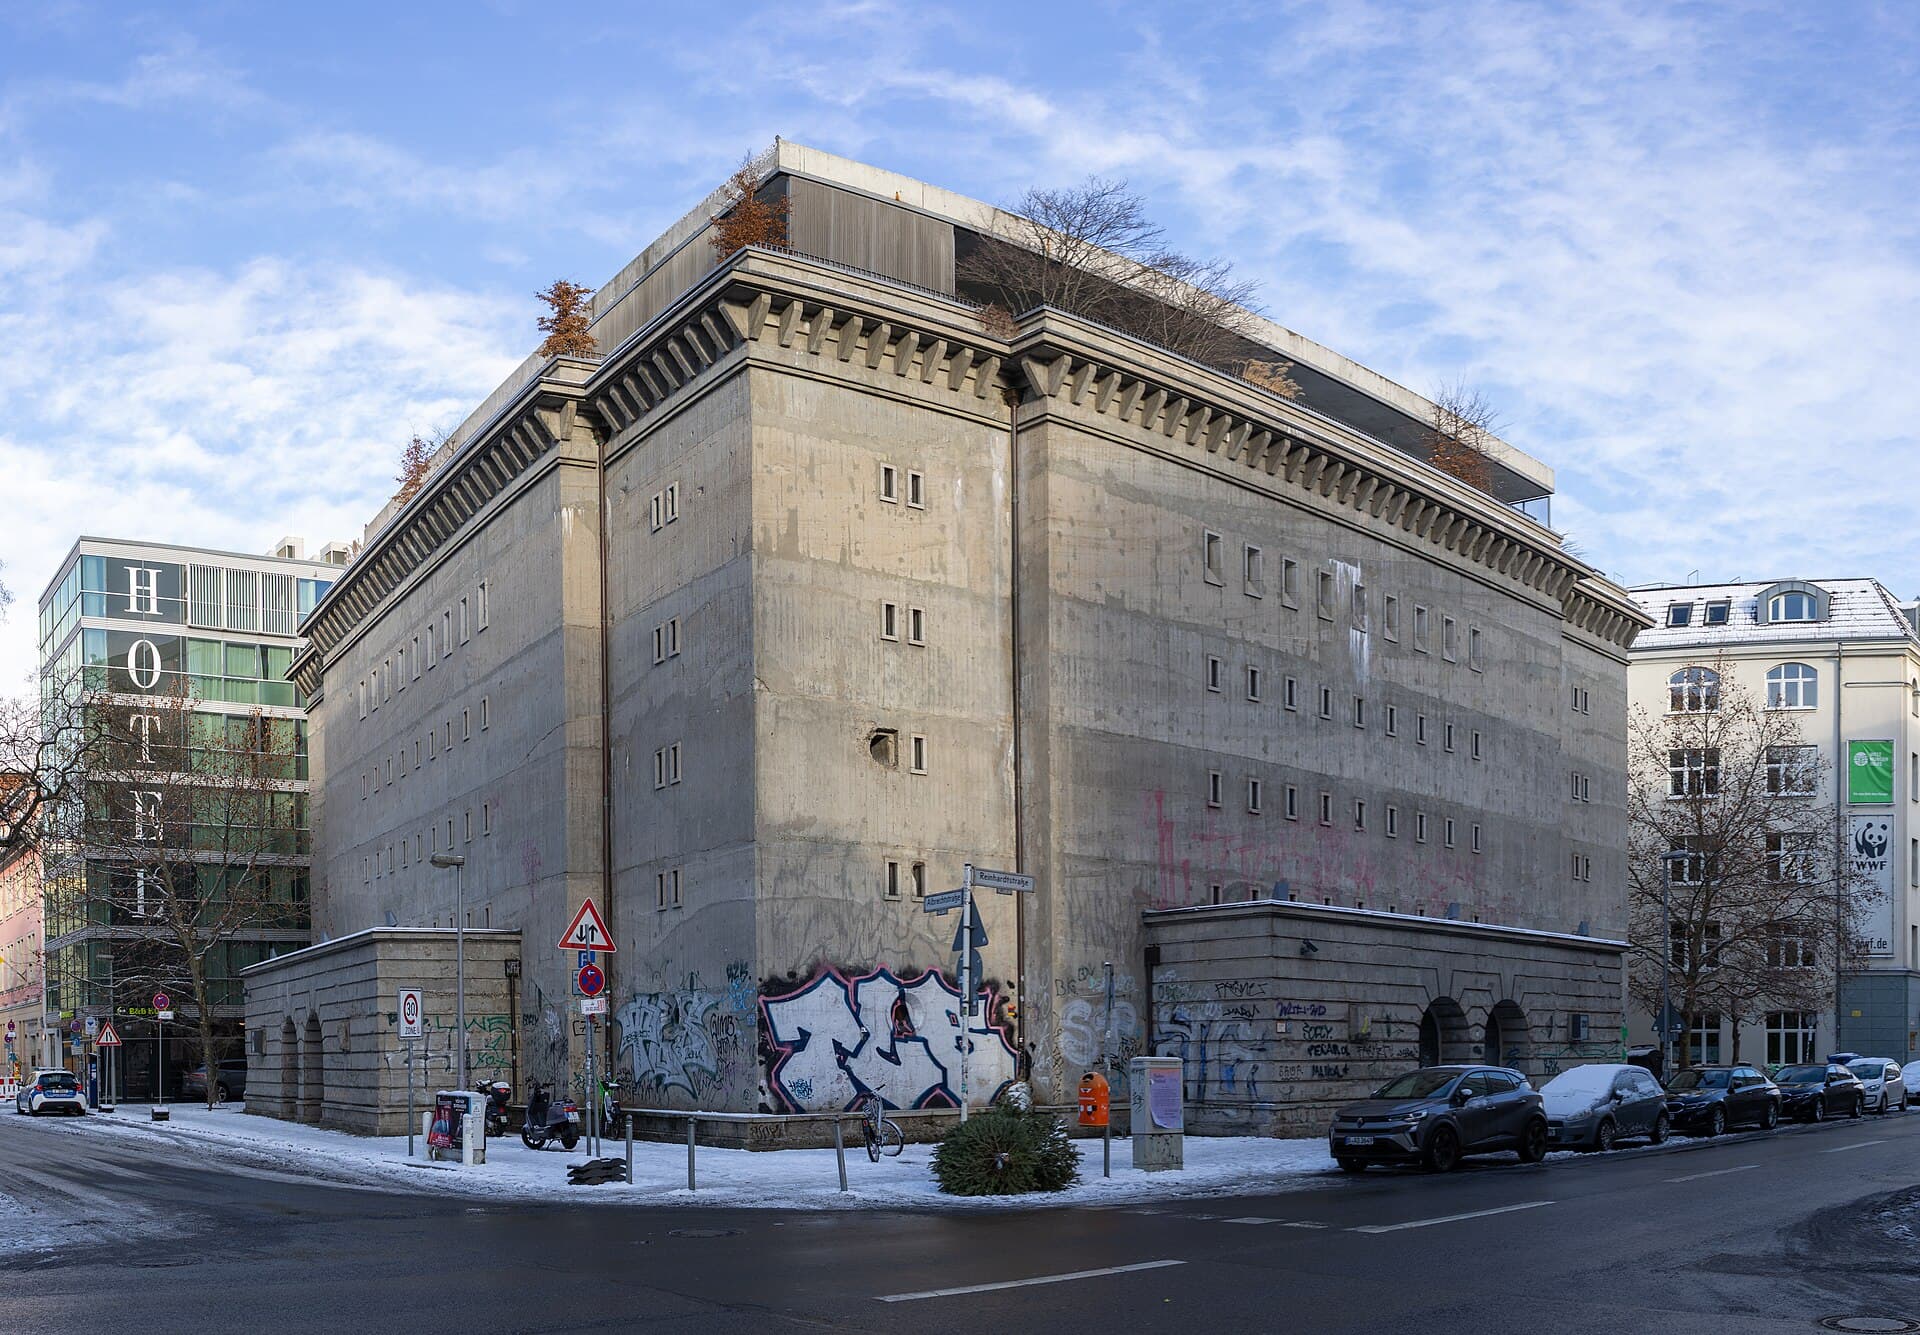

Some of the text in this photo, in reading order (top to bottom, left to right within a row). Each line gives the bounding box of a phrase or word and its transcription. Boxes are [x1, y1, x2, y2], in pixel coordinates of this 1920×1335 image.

[1855, 861, 1887, 870] WWF
[979, 871, 1030, 888] Reinhardtstraße
[407, 1001, 416, 1016] 30
[405, 1026, 417, 1034] ZONE
